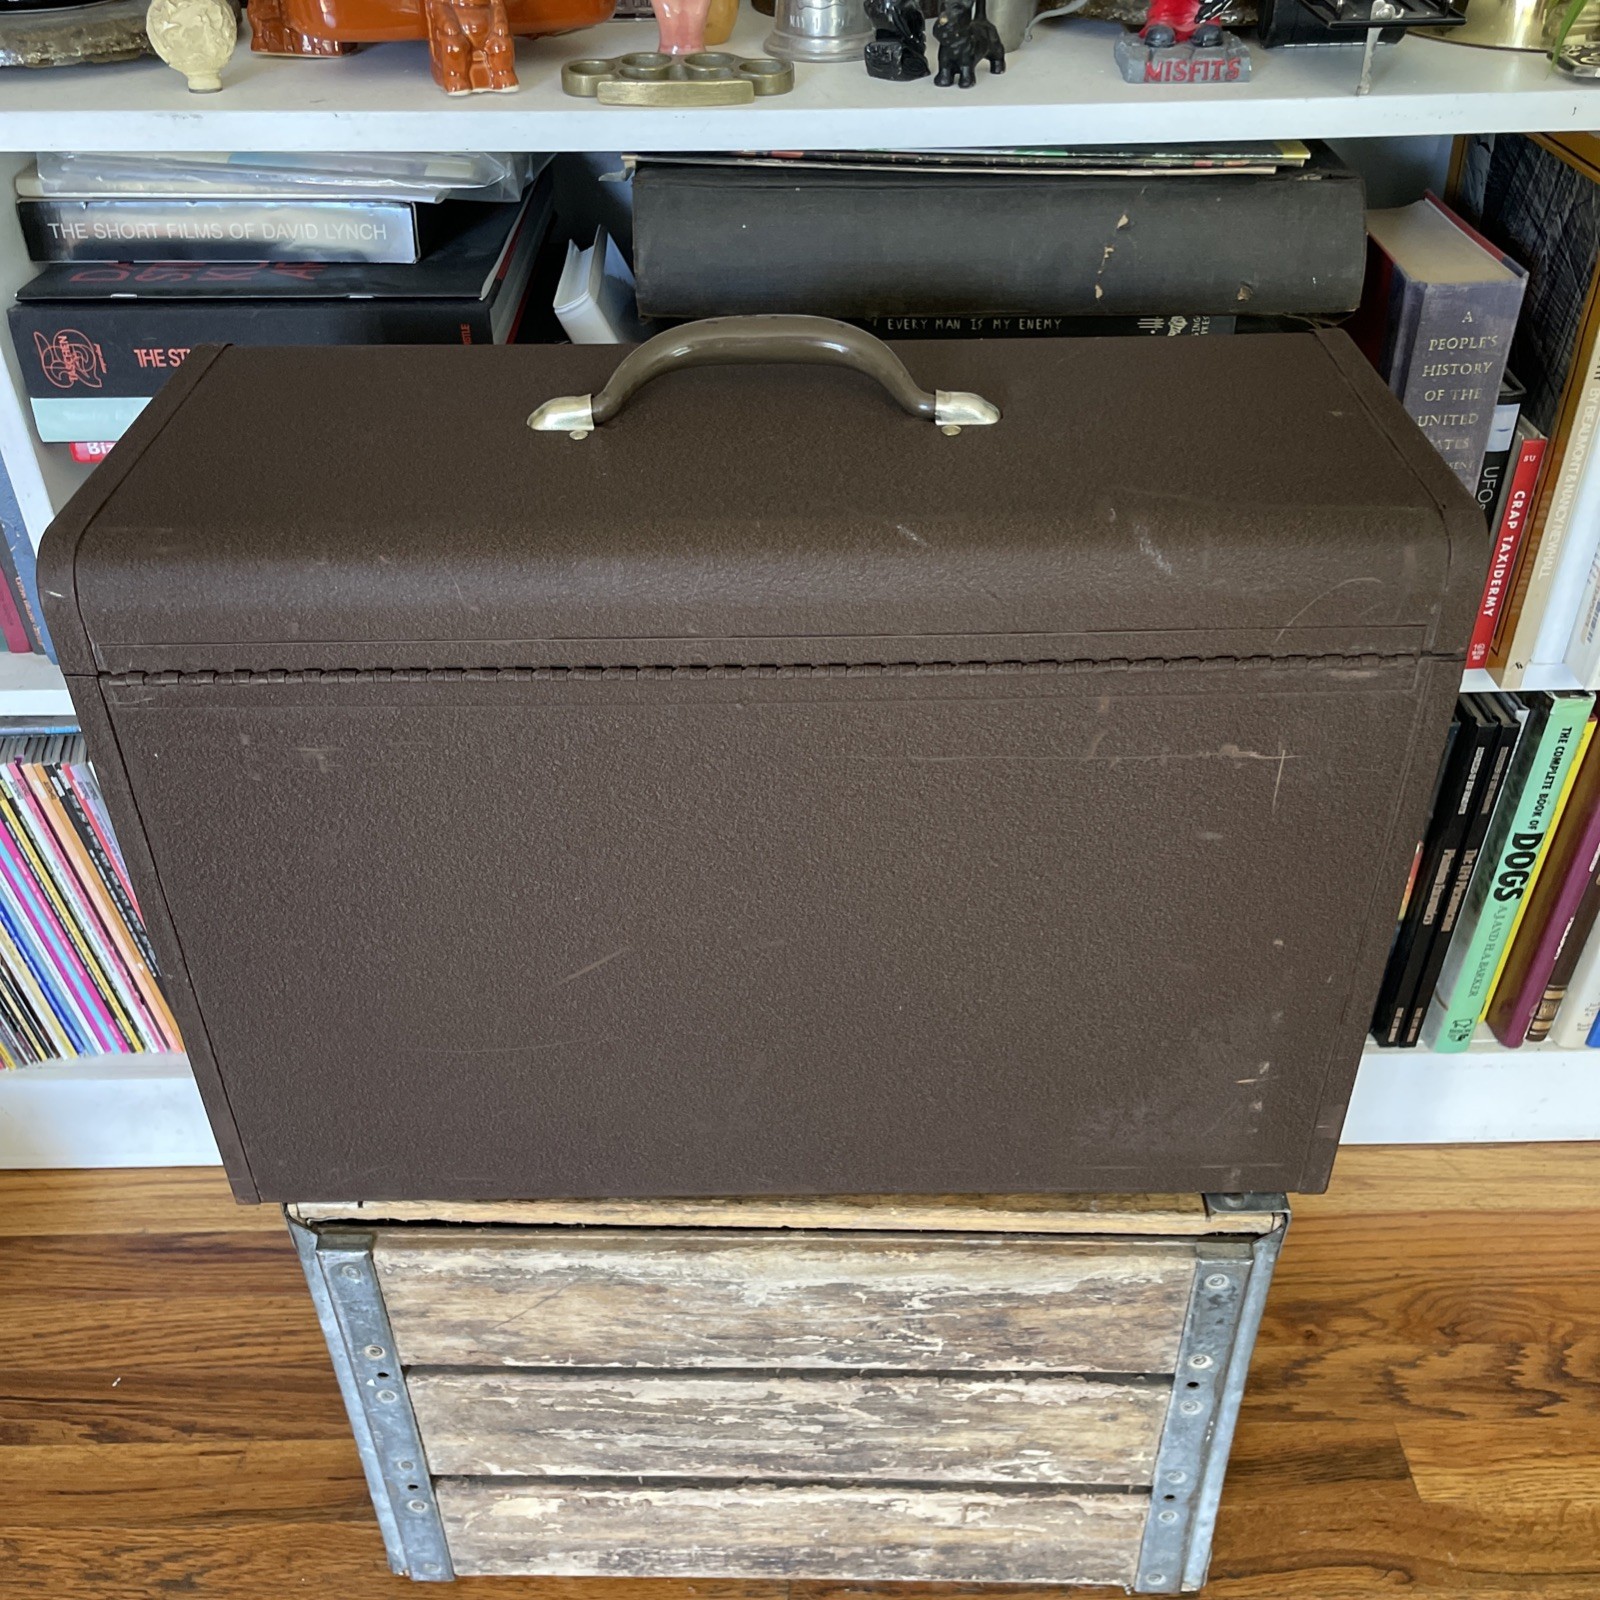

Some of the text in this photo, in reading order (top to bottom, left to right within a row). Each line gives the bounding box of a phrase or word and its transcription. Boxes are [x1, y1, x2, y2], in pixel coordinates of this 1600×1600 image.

[1144, 57, 1241, 83] MISFITS
[47, 222, 386, 240] THE SHORT FILMS OF DAVID LYNCH
[888, 317, 1063, 331] EVERY MAN IS MY ENEMY
[1461, 311, 1473, 323] A
[1428, 335, 1498, 351] PEOPLE'S
[133, 348, 167, 368] THE
[1422, 361, 1493, 377] HISTORY
[1424, 388, 1483, 402] OF THE
[1587, 387, 1600, 404] BY
[1417, 413, 1479, 427] UNITED
[1568, 405, 1597, 474] BEAUMONT
[1553, 484, 1575, 523] NANCY
[1482, 490, 1526, 617] CRAP TAXIDERMY
[1538, 523, 1564, 579] NEWHALL
[1527, 726, 1573, 830] THE COMPLETE BOOK OF
[1493, 832, 1545, 902] DOGS
[1467, 960, 1490, 998] BARKER
